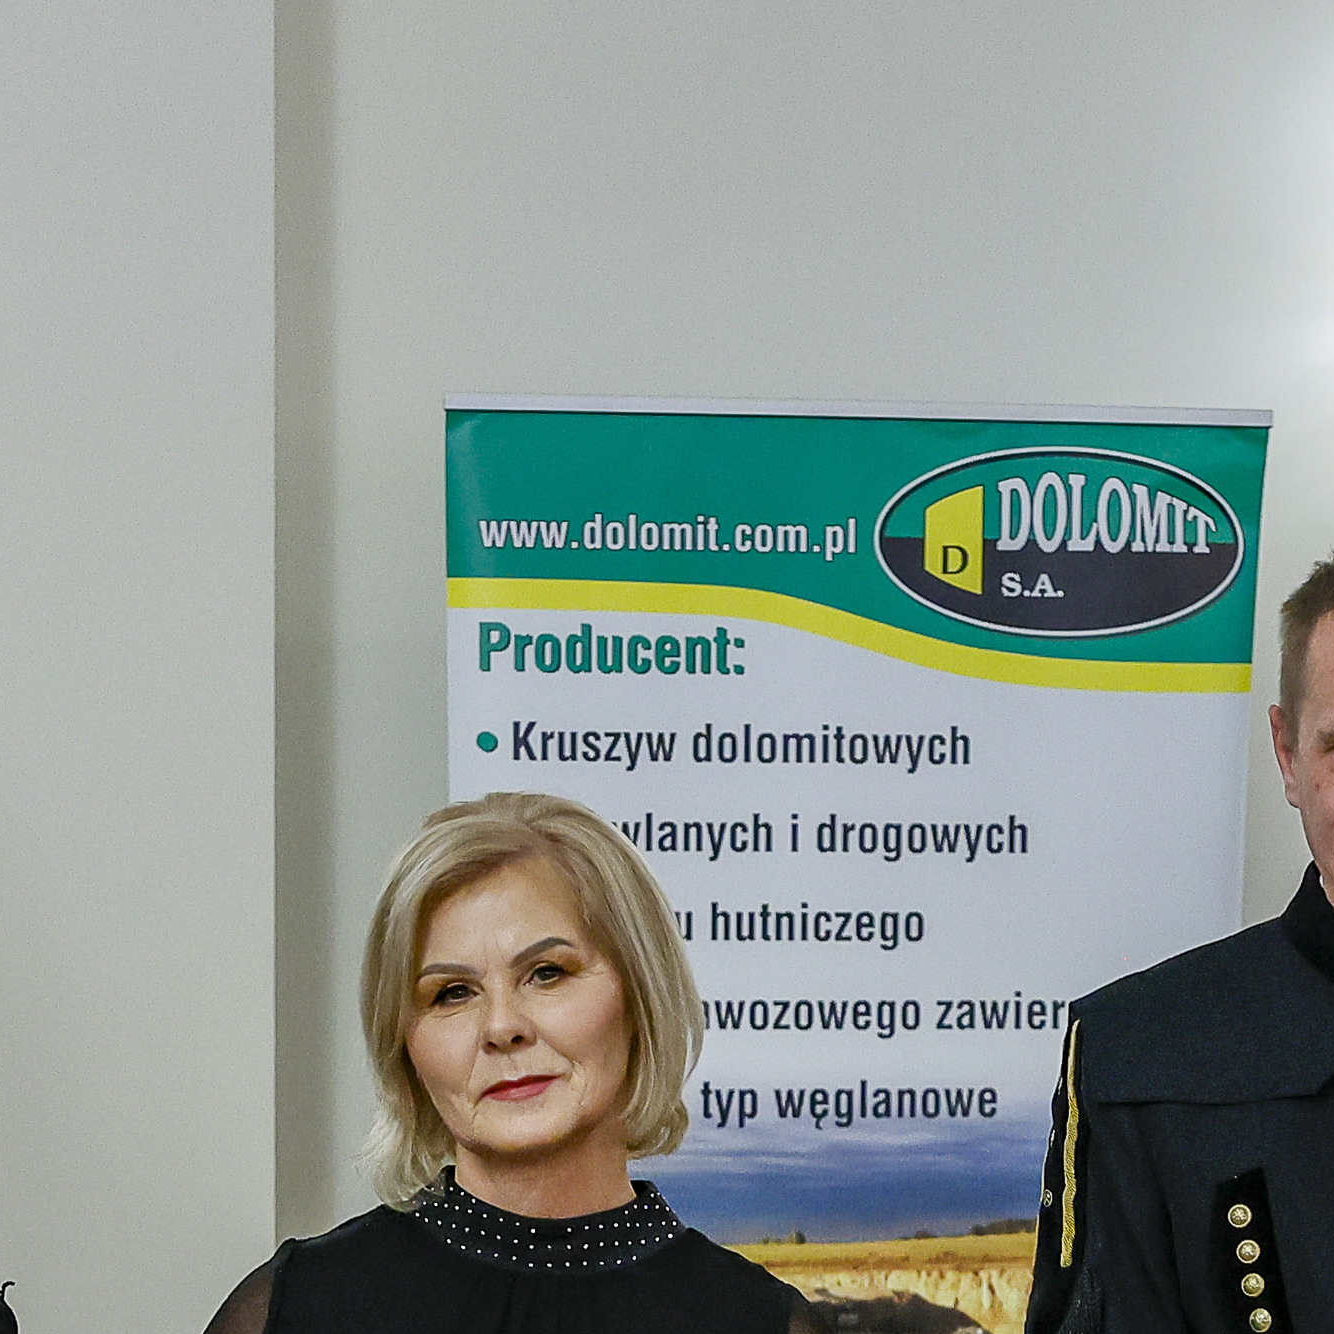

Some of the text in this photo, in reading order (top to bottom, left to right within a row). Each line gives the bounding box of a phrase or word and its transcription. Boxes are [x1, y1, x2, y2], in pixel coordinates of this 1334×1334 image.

[478, 513, 857, 562] www.dolomit.com.pl
[996, 471, 1218, 557] DOLOMIT
[940, 545, 969, 575] D
[1001, 572, 1064, 598] S.A.
[478, 621, 747, 677] Producent:
[511, 721, 972, 775] Kruszyw dolomitowych
[790, 814, 799, 852] i
[817, 814, 1029, 864] drogowych
[710, 902, 925, 950] hutniczego
[936, 991, 1065, 1030] zawier
[701, 1079, 999, 1129] typ węglanowe
